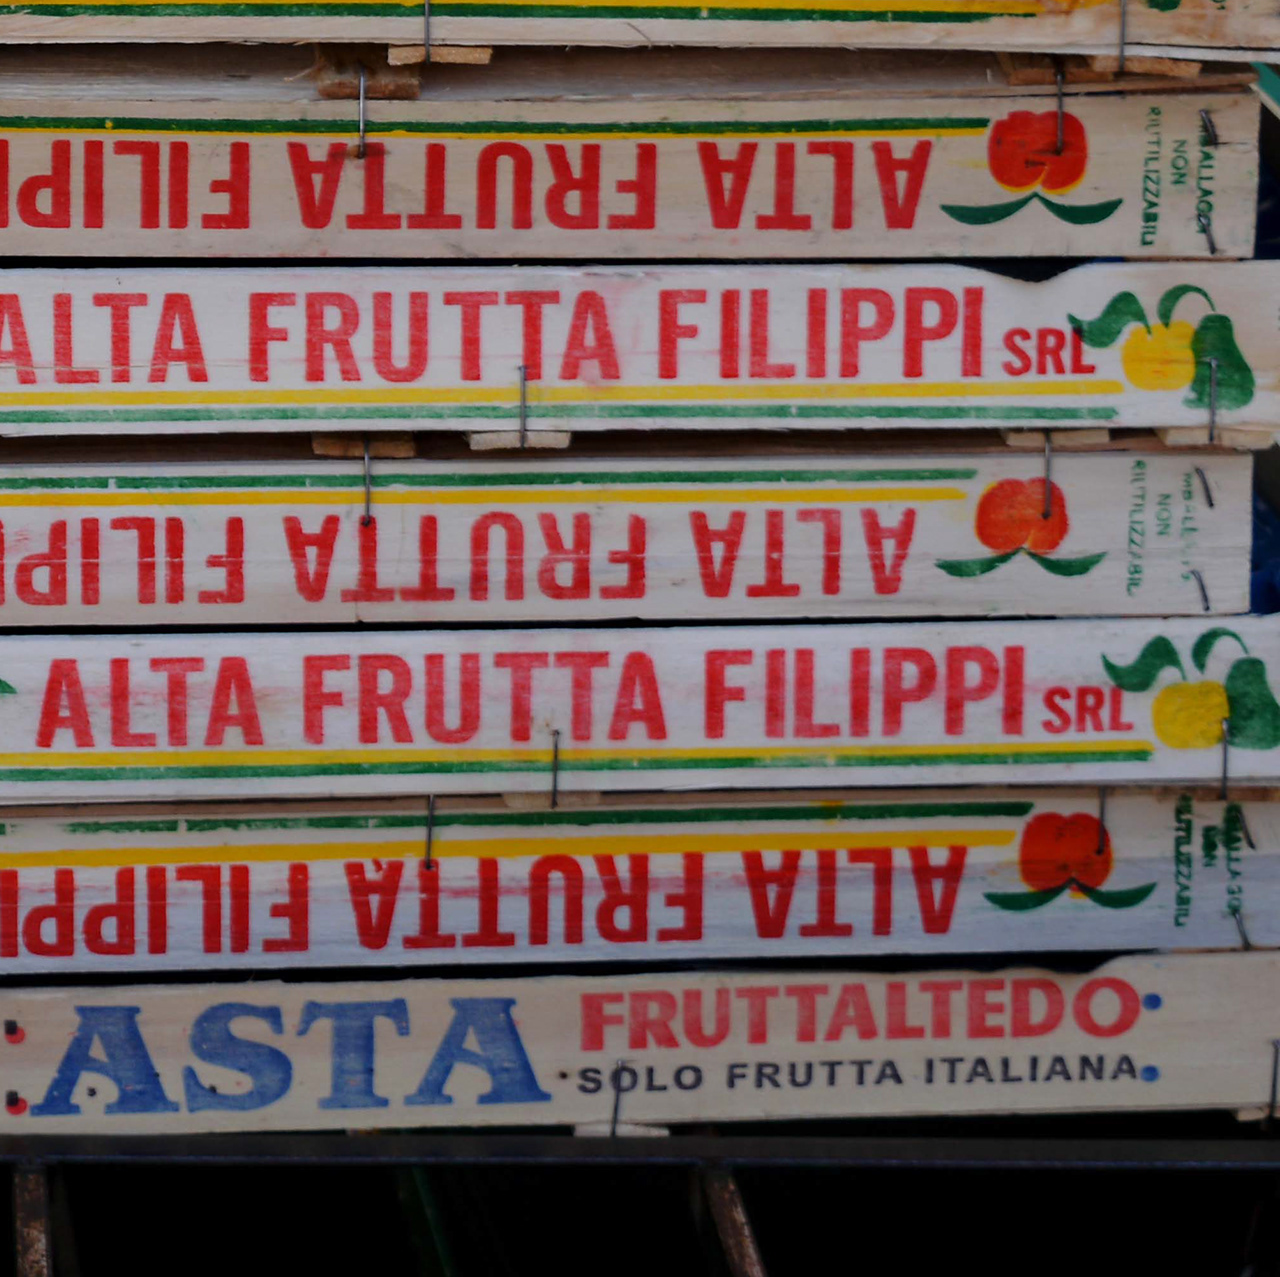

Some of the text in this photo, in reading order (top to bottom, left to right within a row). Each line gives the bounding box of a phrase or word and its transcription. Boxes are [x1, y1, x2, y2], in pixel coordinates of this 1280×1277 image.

[287, 140, 658, 230] FRUTTA
[697, 139, 933, 231] ALTA
[1171, 138, 1188, 187] NON
[248, 290, 621, 383] FRUTTA
[658, 287, 984, 379] FILIPPI
[1003, 328, 1096, 376] SRL
[284, 511, 647, 603] FRUTTA
[691, 508, 916, 598] ALTA
[36, 646, 1133, 748] ALTA FRUTTA FILIPPI SRL
[345, 853, 705, 950] FRUTTA
[742, 846, 969, 938] ALTA
[30, 997, 552, 1117] ASTA
[579, 976, 1142, 1052] FRUTTALTEDO
[576, 1054, 1140, 1095] SOLO FRUTTA ITALIANA
